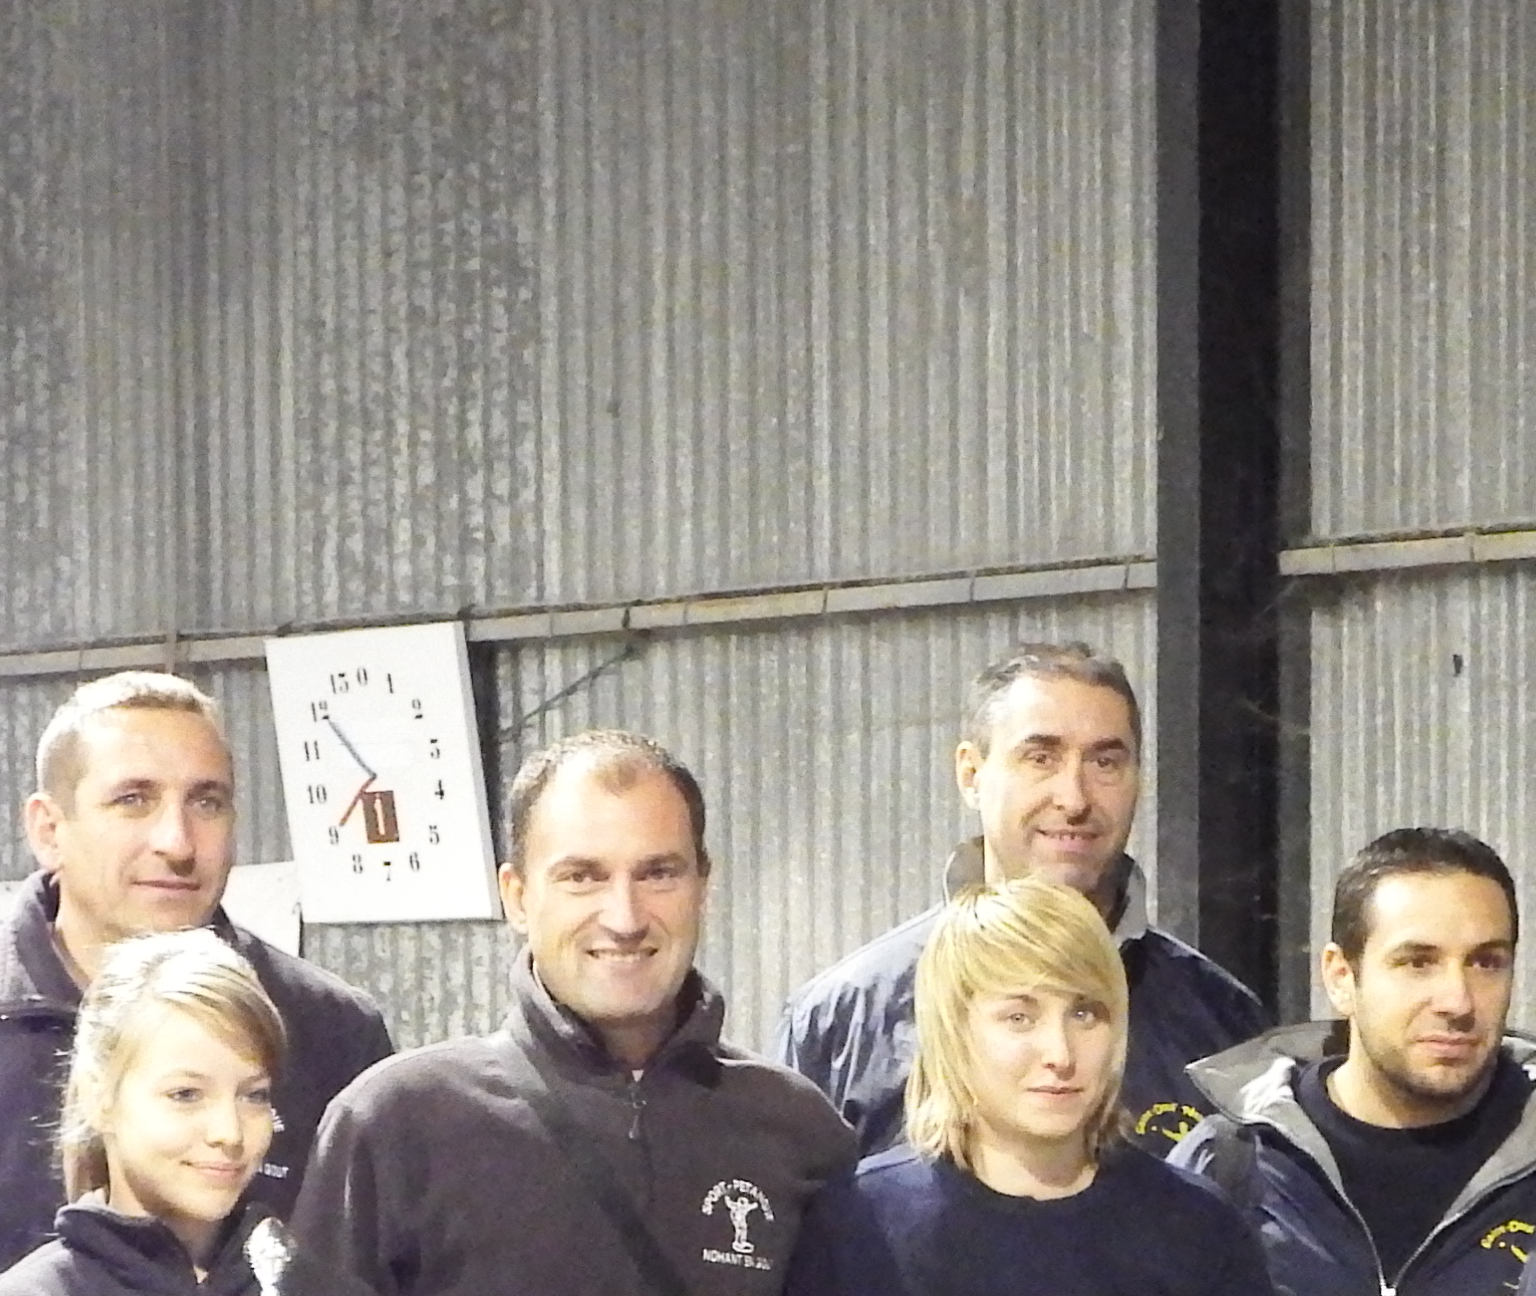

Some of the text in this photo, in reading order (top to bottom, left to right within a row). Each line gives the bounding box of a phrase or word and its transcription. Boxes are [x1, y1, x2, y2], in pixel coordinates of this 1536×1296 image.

[356, 667, 368, 687] 0
[387, 673, 394, 694] 1
[304, 740, 320, 761] 11
[307, 783, 327, 804] 10
[435, 780, 445, 800] 4
